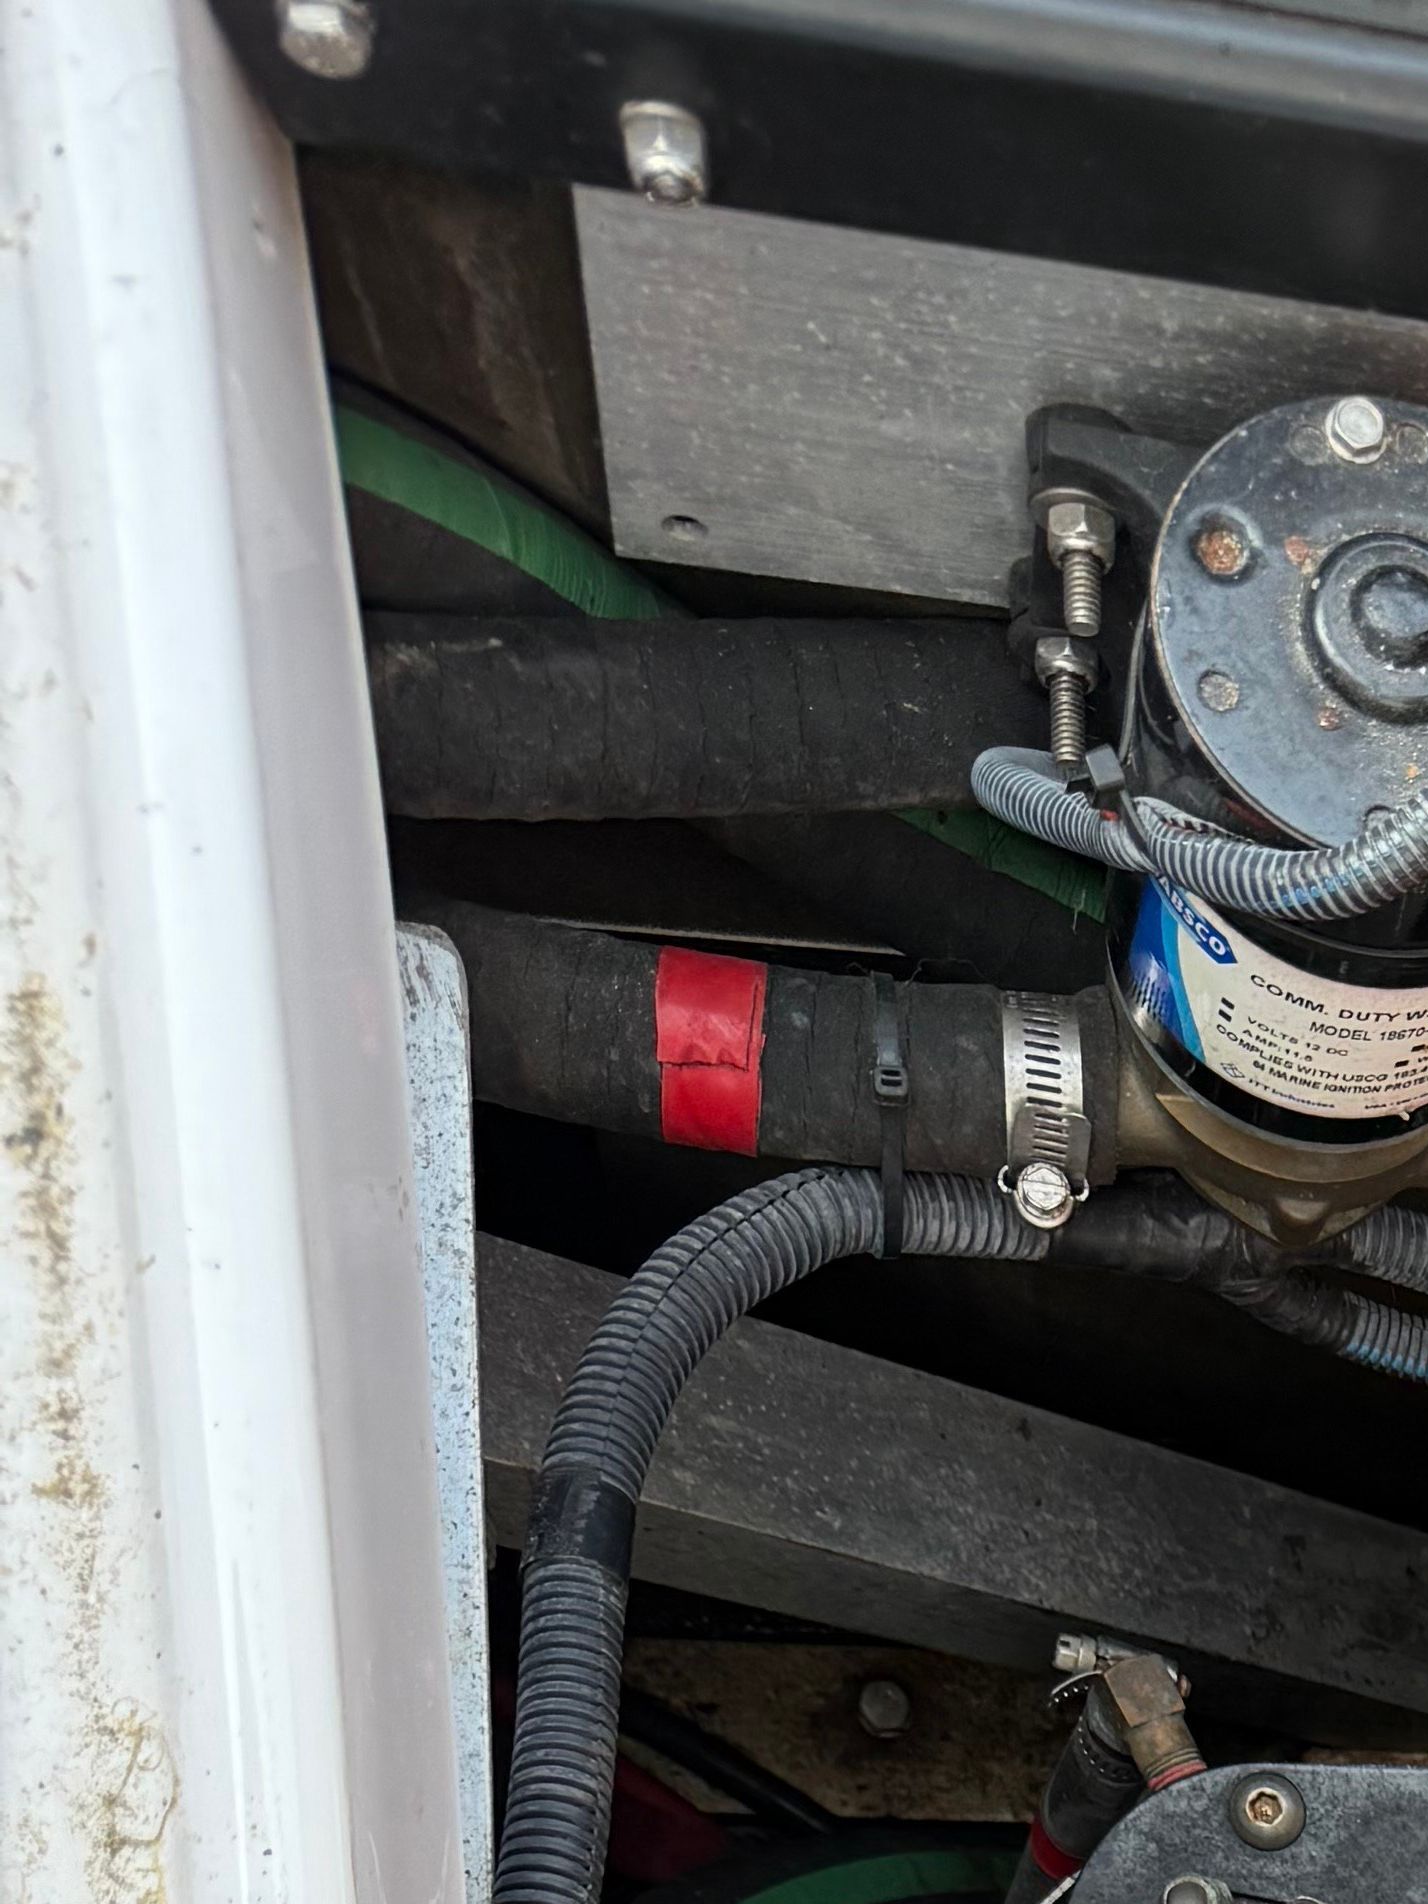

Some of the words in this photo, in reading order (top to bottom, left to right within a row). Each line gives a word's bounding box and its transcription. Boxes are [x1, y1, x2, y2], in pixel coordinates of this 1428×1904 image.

[1158, 873, 1227, 957] ABSCO
[1250, 973, 1329, 1016] COMM.
[1338, 1006, 1403, 1024] DUTY
[1246, 1015, 1303, 1046] VOLTS
[1308, 1020, 1372, 1043] MODEL
[1215, 1023, 1296, 1073] COMPLIES
[1297, 1063, 1339, 1083] WITH
[1268, 1064, 1322, 1092] MARINE
